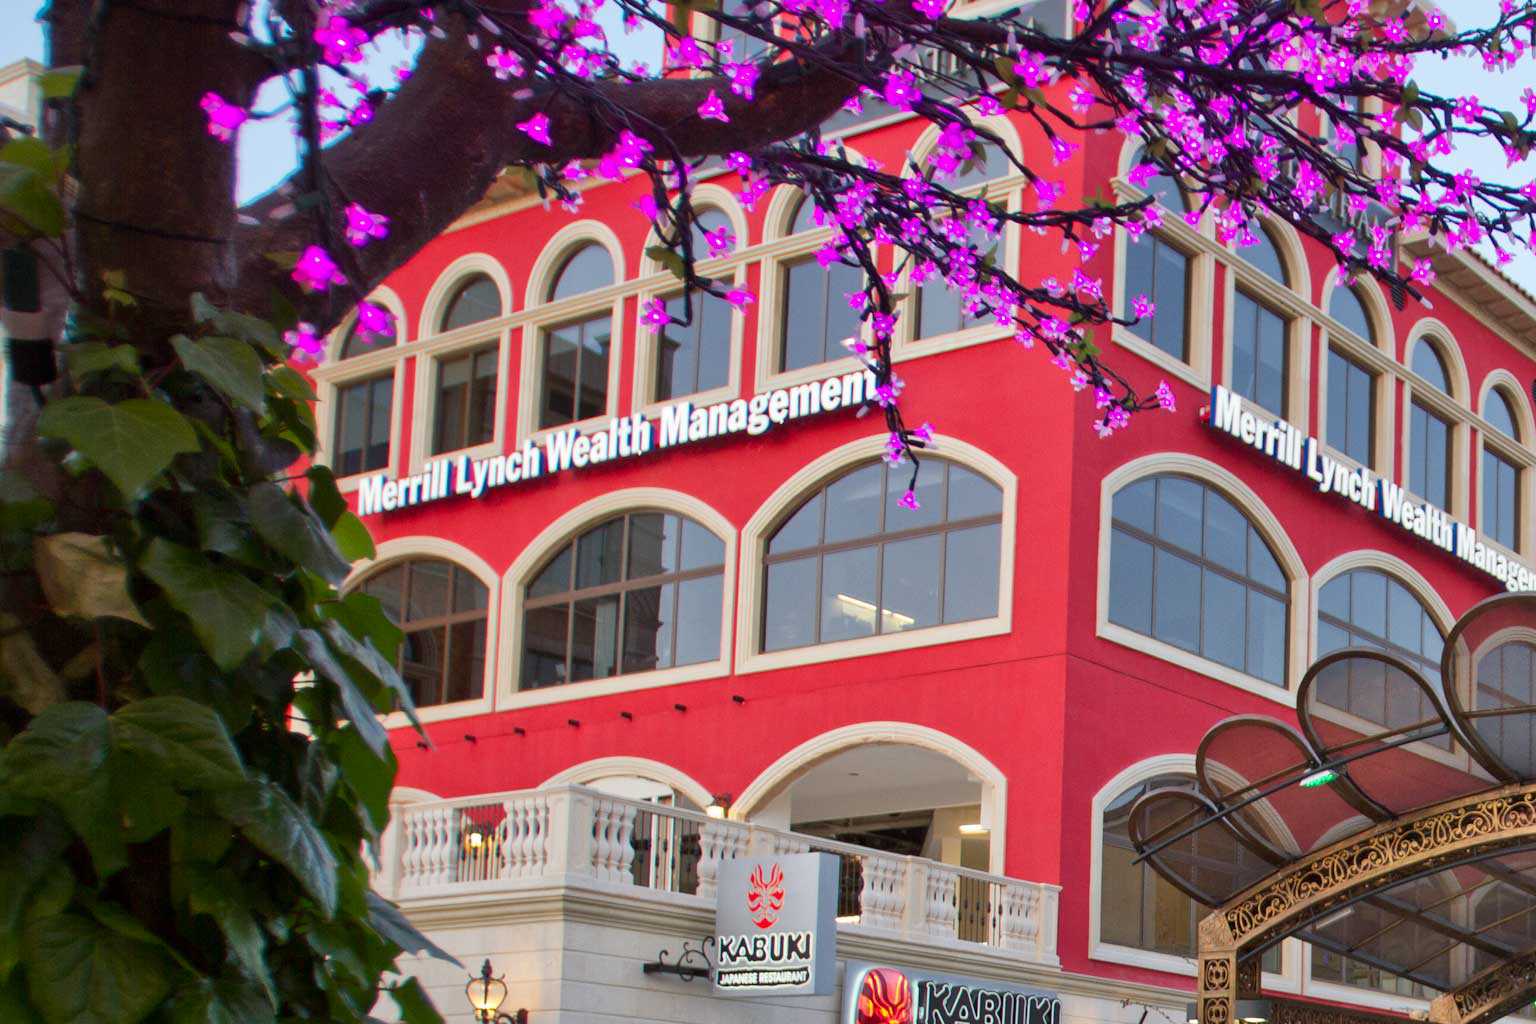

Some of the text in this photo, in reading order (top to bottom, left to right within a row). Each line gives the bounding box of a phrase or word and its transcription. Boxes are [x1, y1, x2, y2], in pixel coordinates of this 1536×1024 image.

[358, 359, 879, 516] Merrill Lynch Wealth Management
[1212, 384, 1302, 470] Merrill
[1304, 437, 1376, 511] Lynch
[1380, 479, 1454, 551] Wealth
[719, 933, 812, 963] KABUKI
[719, 969, 808, 985] JAPANESE RESTAURANT
